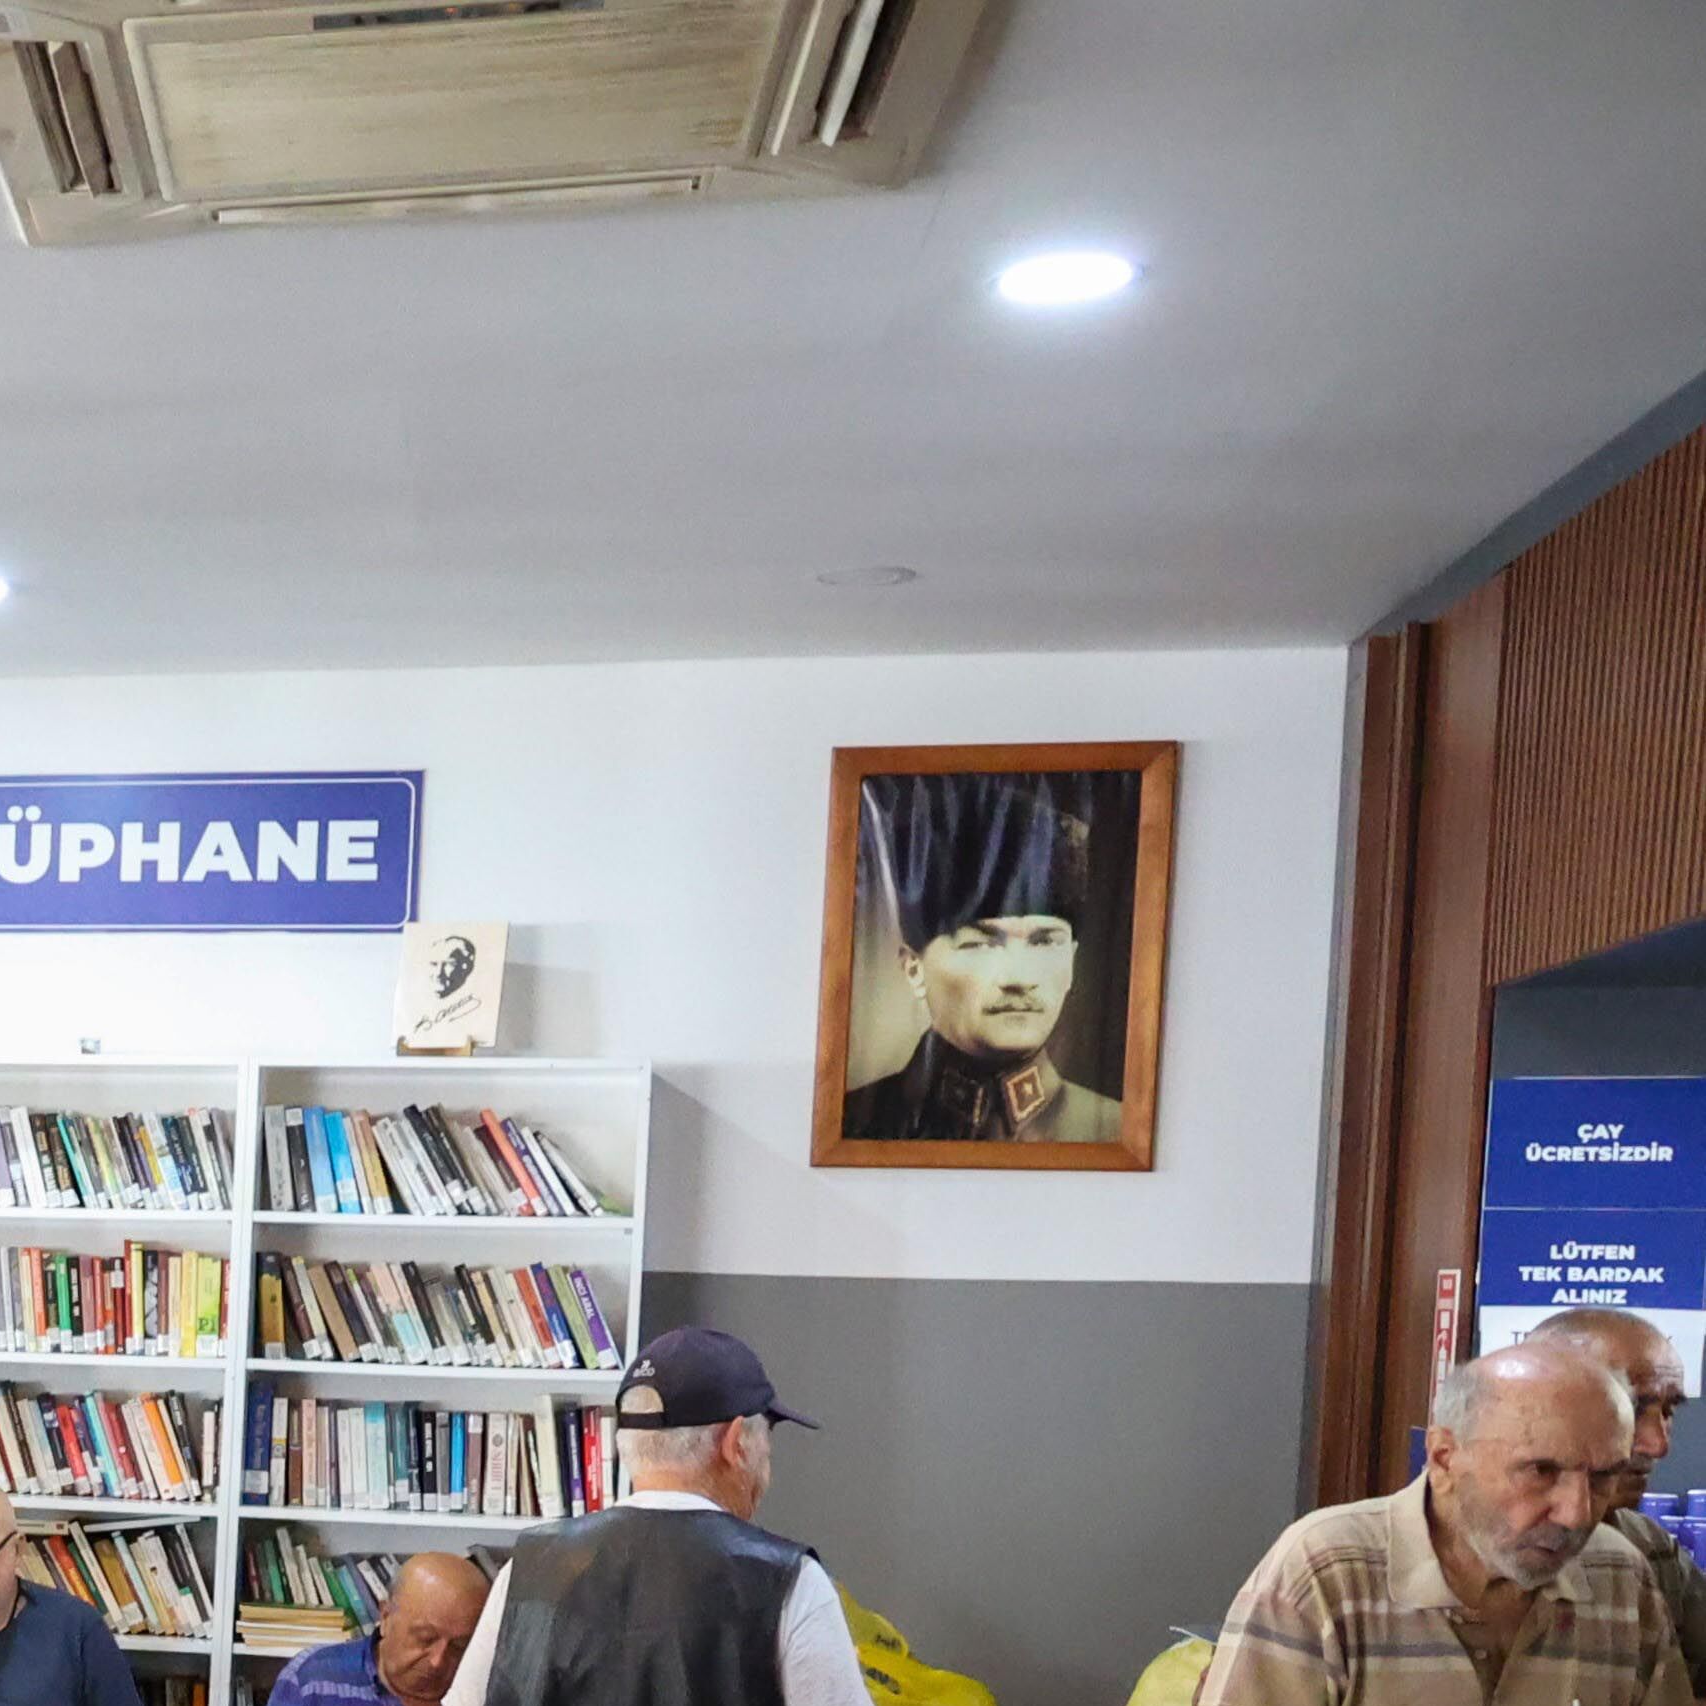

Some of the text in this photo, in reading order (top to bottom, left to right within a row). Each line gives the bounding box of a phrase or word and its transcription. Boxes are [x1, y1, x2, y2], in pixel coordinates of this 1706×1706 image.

[1577, 1124, 1624, 1143] ÇAY
[1525, 1141, 1673, 1162] ÜCRETSİZDİR
[1550, 1241, 1635, 1261] LÜTFEN
[1519, 1267, 1664, 1283] TEK BARDAK
[1552, 1289, 1627, 1304] ALINIZ
